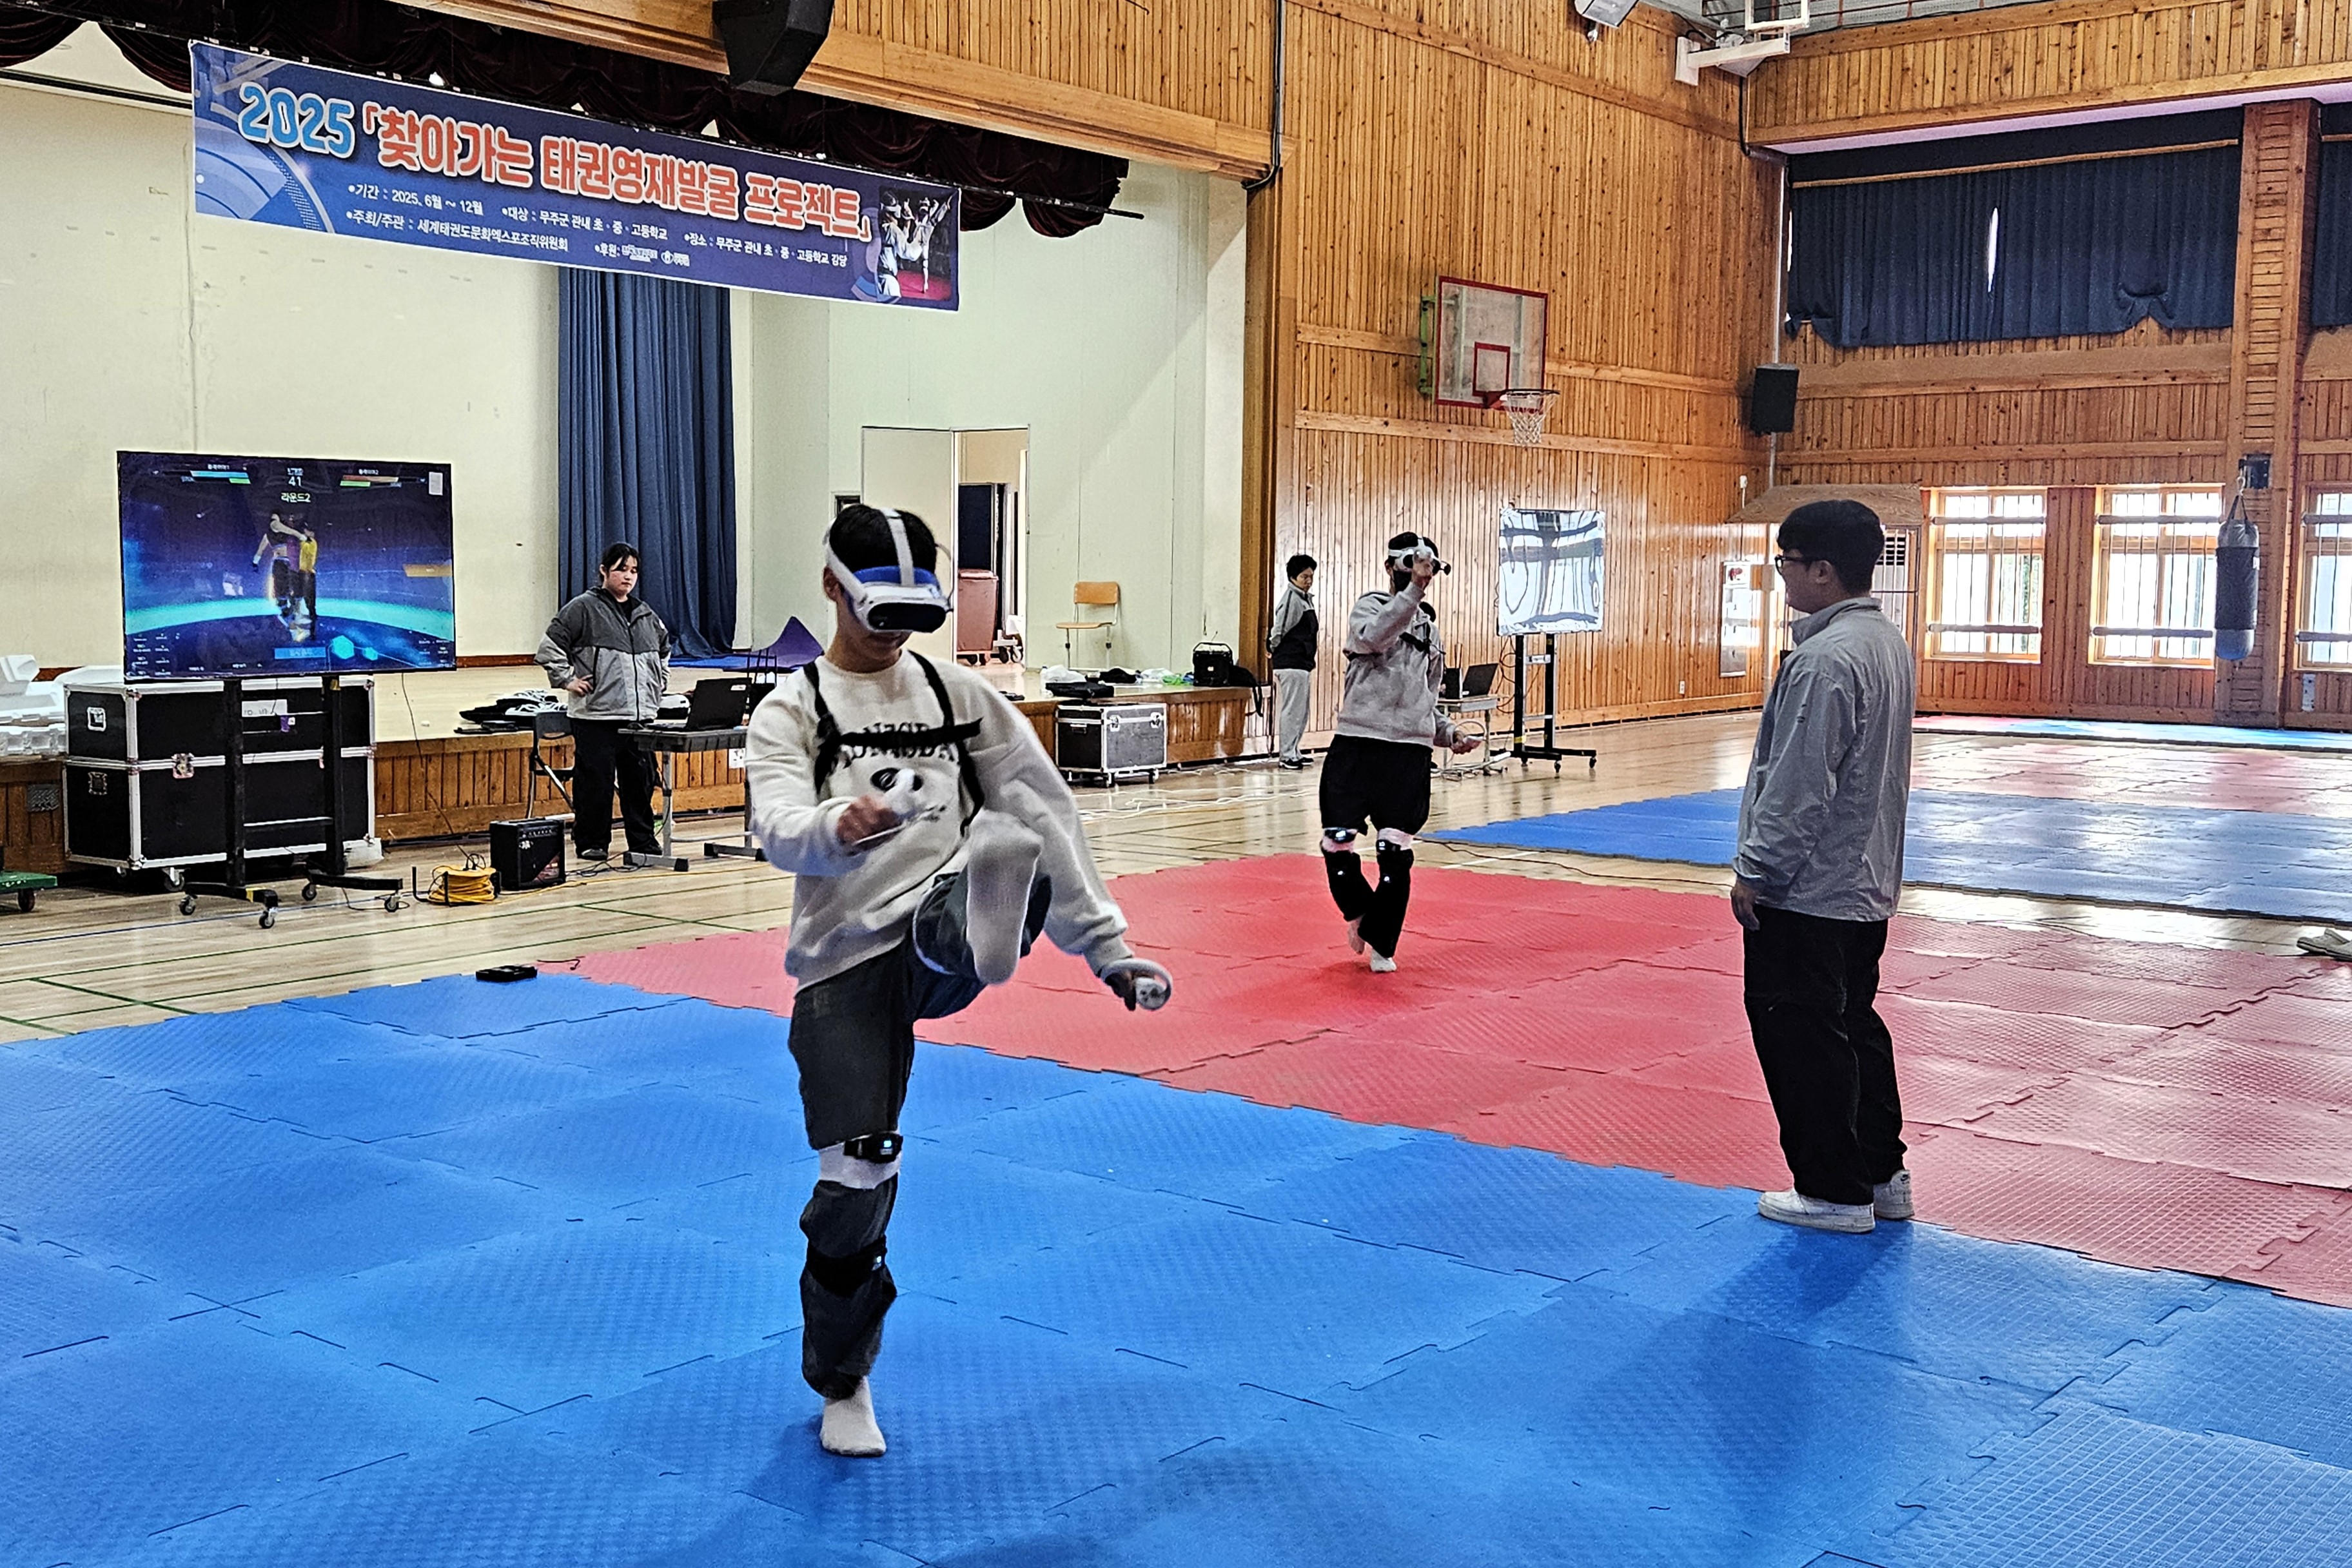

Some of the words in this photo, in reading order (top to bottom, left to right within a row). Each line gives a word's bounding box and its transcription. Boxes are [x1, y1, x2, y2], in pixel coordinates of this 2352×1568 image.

[239, 81, 355, 158] 2025
[540, 135, 740, 220] 태권영재발굴
[355, 183, 379, 200] 기간
[391, 190, 422, 206] 2025.
[424, 194, 442, 210] 6월
[460, 200, 484, 216] 12월
[353, 209, 404, 230] 주최/주관
[507, 206, 528, 222] 대상
[540, 210, 569, 227] 무주군
[571, 215, 591, 230] 관내
[690, 232, 707, 246] 장소
[716, 236, 742, 252] 무주군
[744, 240, 761, 255] 관내
[831, 253, 847, 268] 강당
[288, 476, 301, 486] 41
